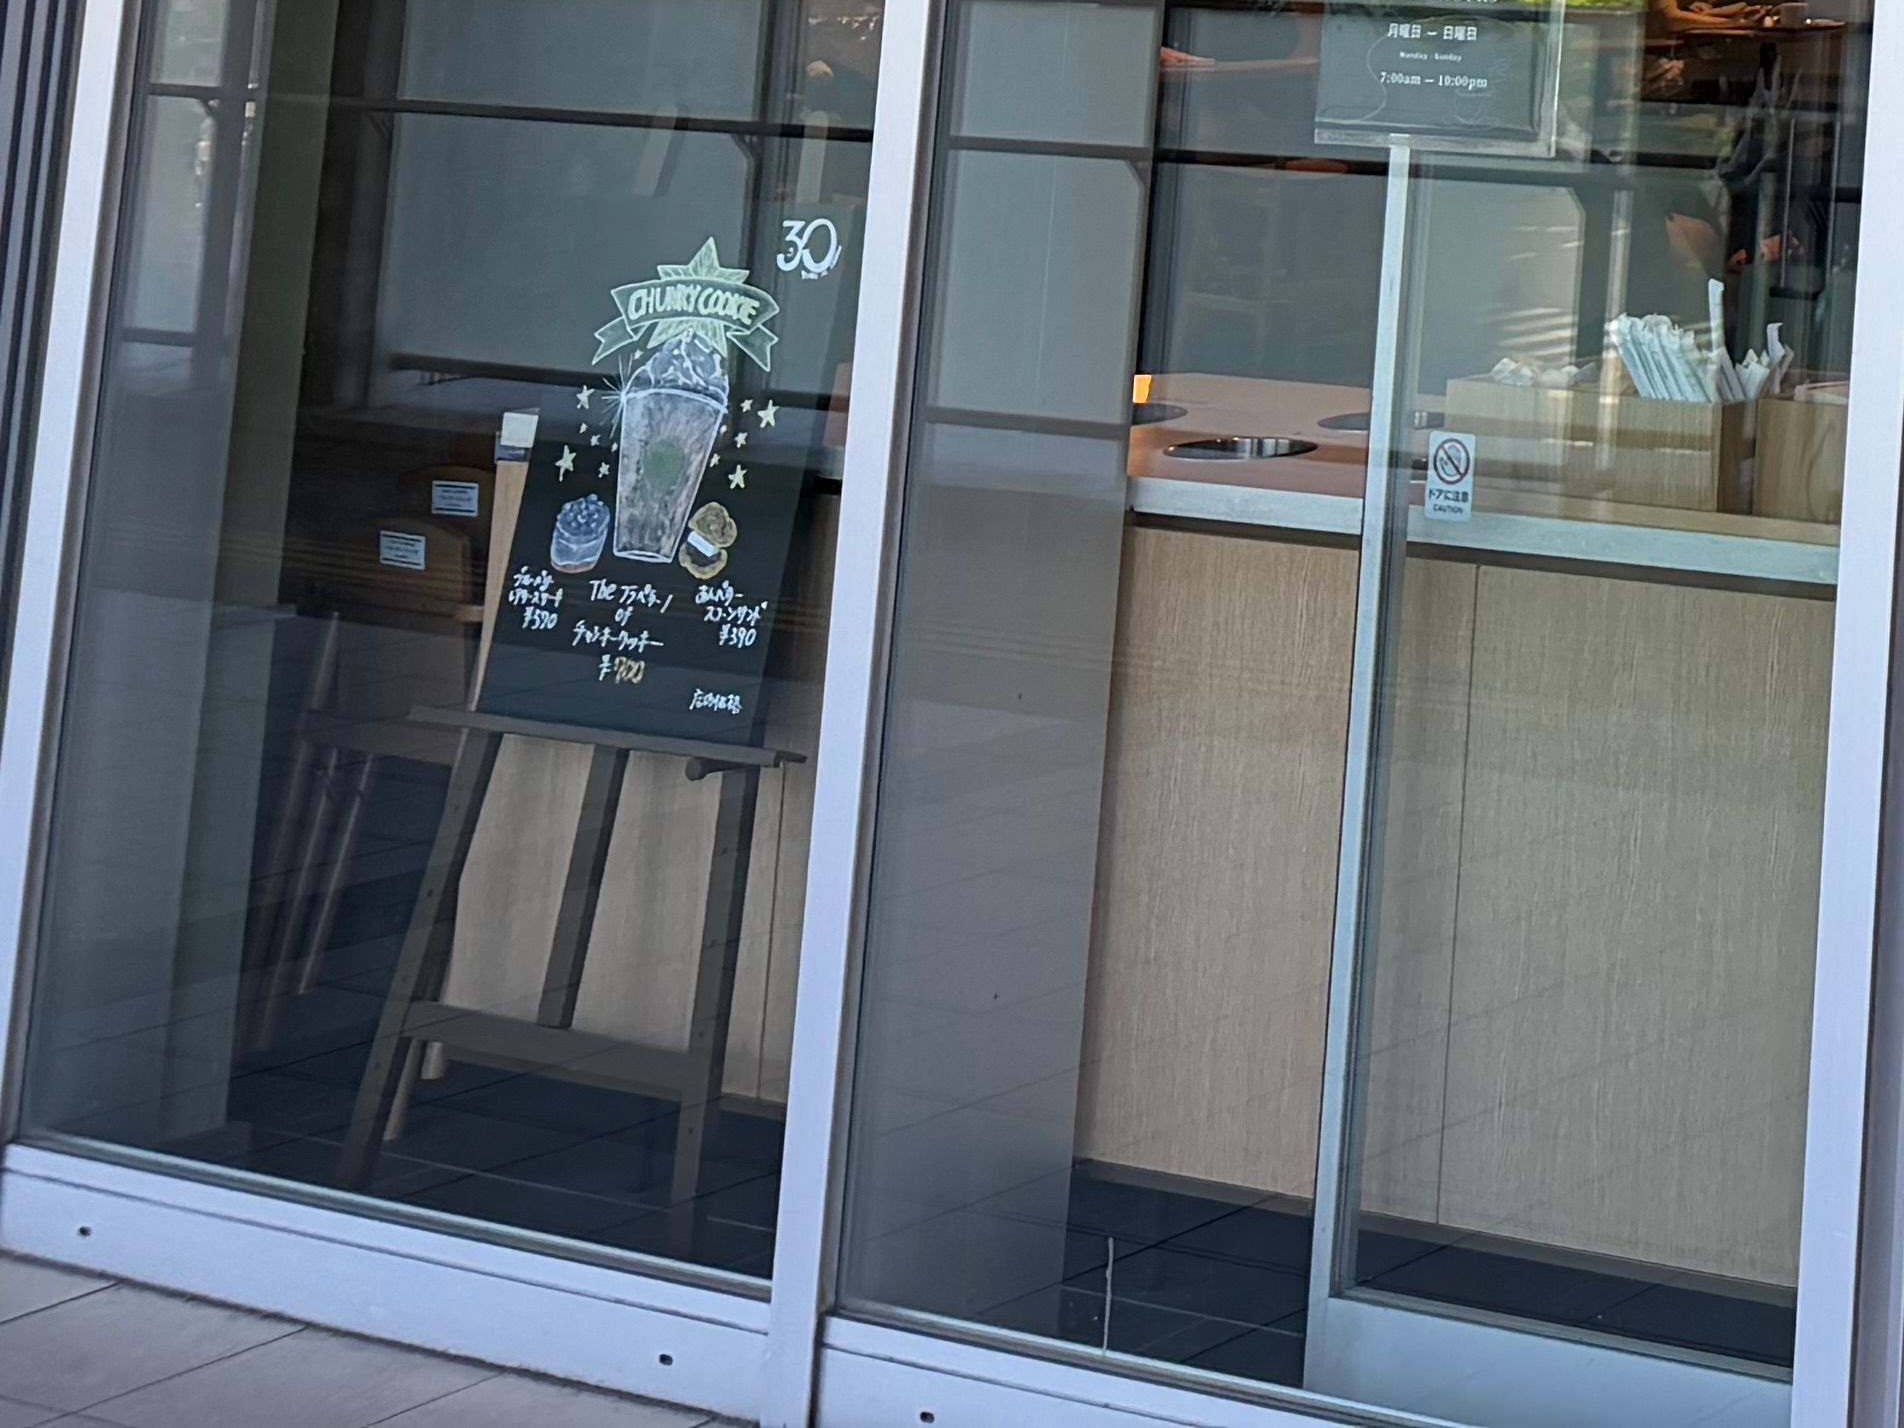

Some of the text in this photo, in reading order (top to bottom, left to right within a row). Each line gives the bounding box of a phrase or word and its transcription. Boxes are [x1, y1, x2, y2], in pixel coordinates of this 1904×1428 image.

[1386, 22, 1422, 40] 月曜日
[1442, 24, 1478, 42] 日曜日
[1379, 71, 1421, 86] 7:00am
[1437, 74, 1488, 91] 10:00pm
[777, 218, 838, 274] 30
[1434, 505, 1464, 514] CAUTION
[588, 578, 618, 601] The
